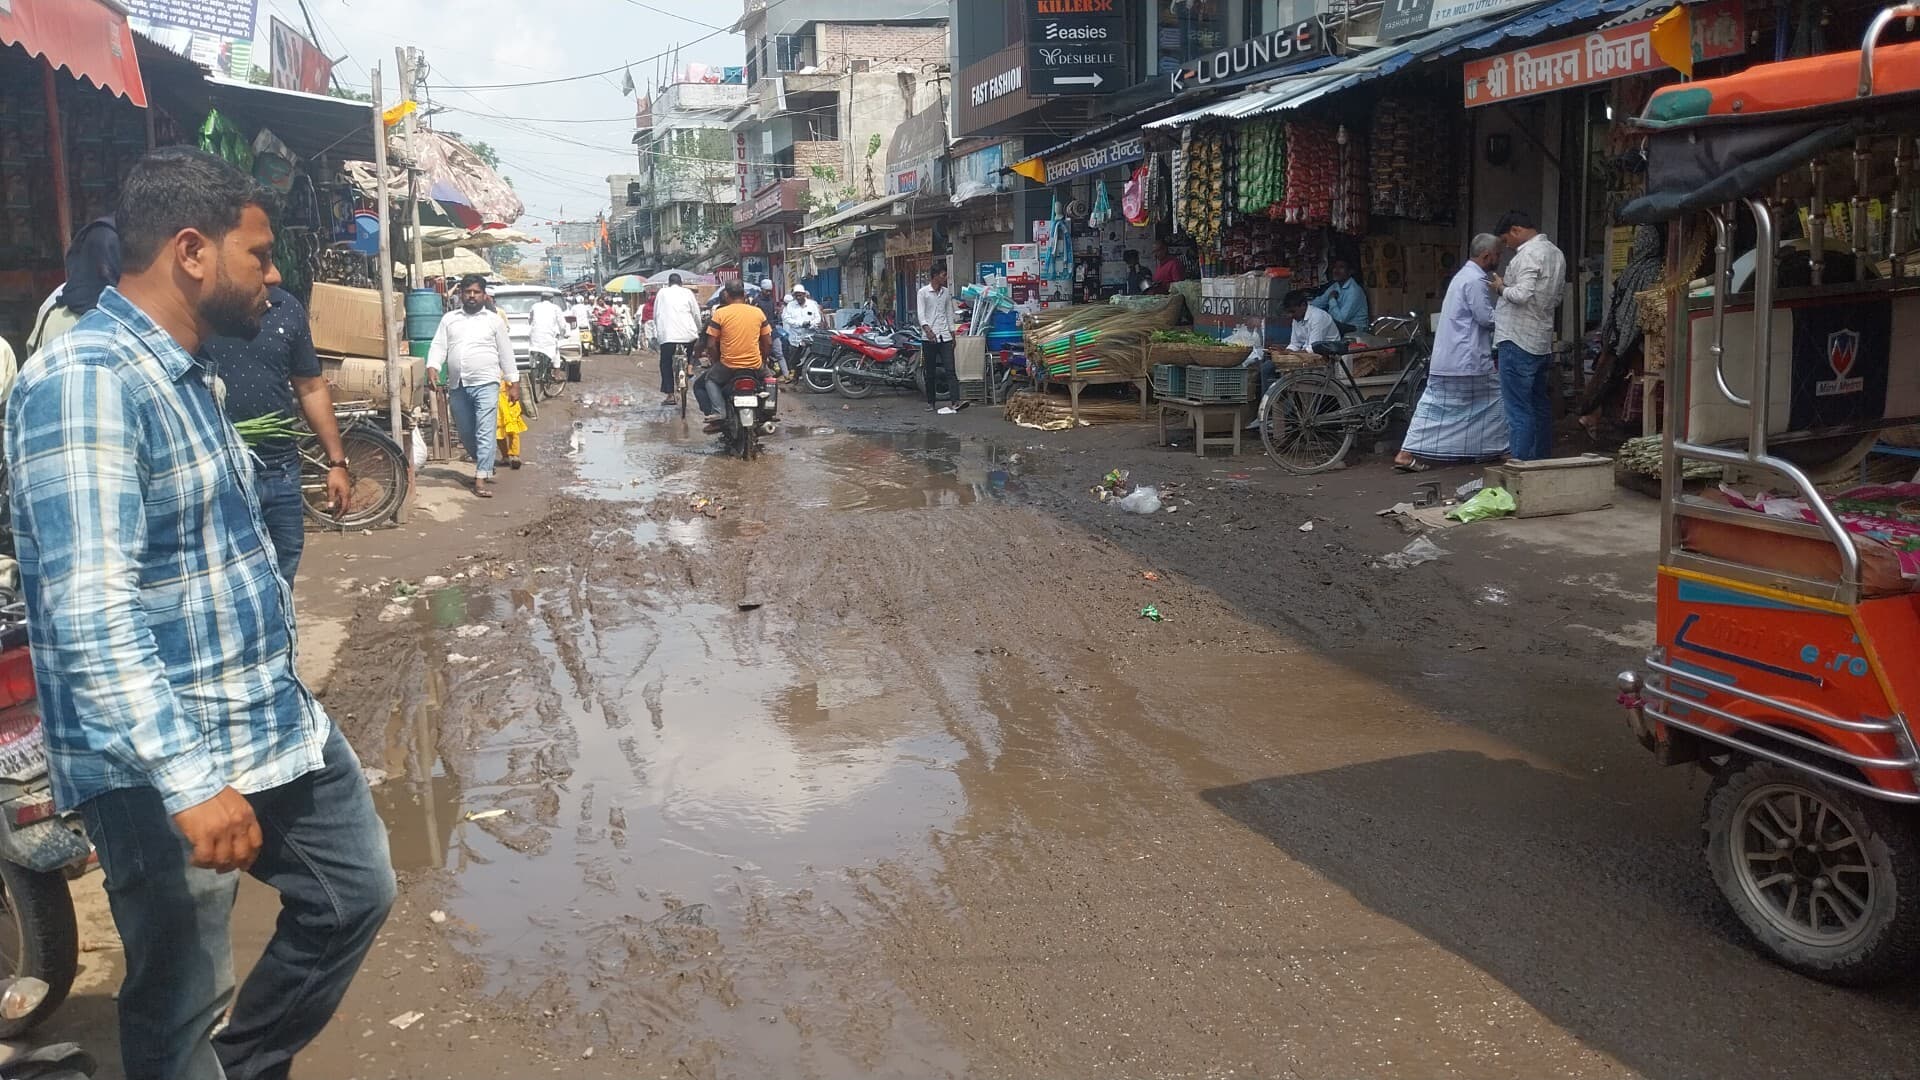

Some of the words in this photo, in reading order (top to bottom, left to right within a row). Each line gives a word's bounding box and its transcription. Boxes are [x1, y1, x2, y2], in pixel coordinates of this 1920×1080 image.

[1452, 2, 1474, 15] MULTI
[1058, 24, 1108, 40] easies
[1384, 17, 1410, 30] FASHION
[1411, 13, 1424, 24] HUB
[1085, 53, 1117, 64] BELLE
[1170, 21, 1313, 94] K-LOUNGE
[1486, 56, 1508, 98] श्री
[1513, 47, 1581, 93] सिमरन
[1585, 32, 1650, 79] किचन
[971, 80, 989, 108] FAST
[989, 65, 1023, 103] FASHION
[736, 132, 748, 202] SUMIT
[1046, 157, 1080, 182] सिमरन
[719, 270, 739, 283] SUMIT
